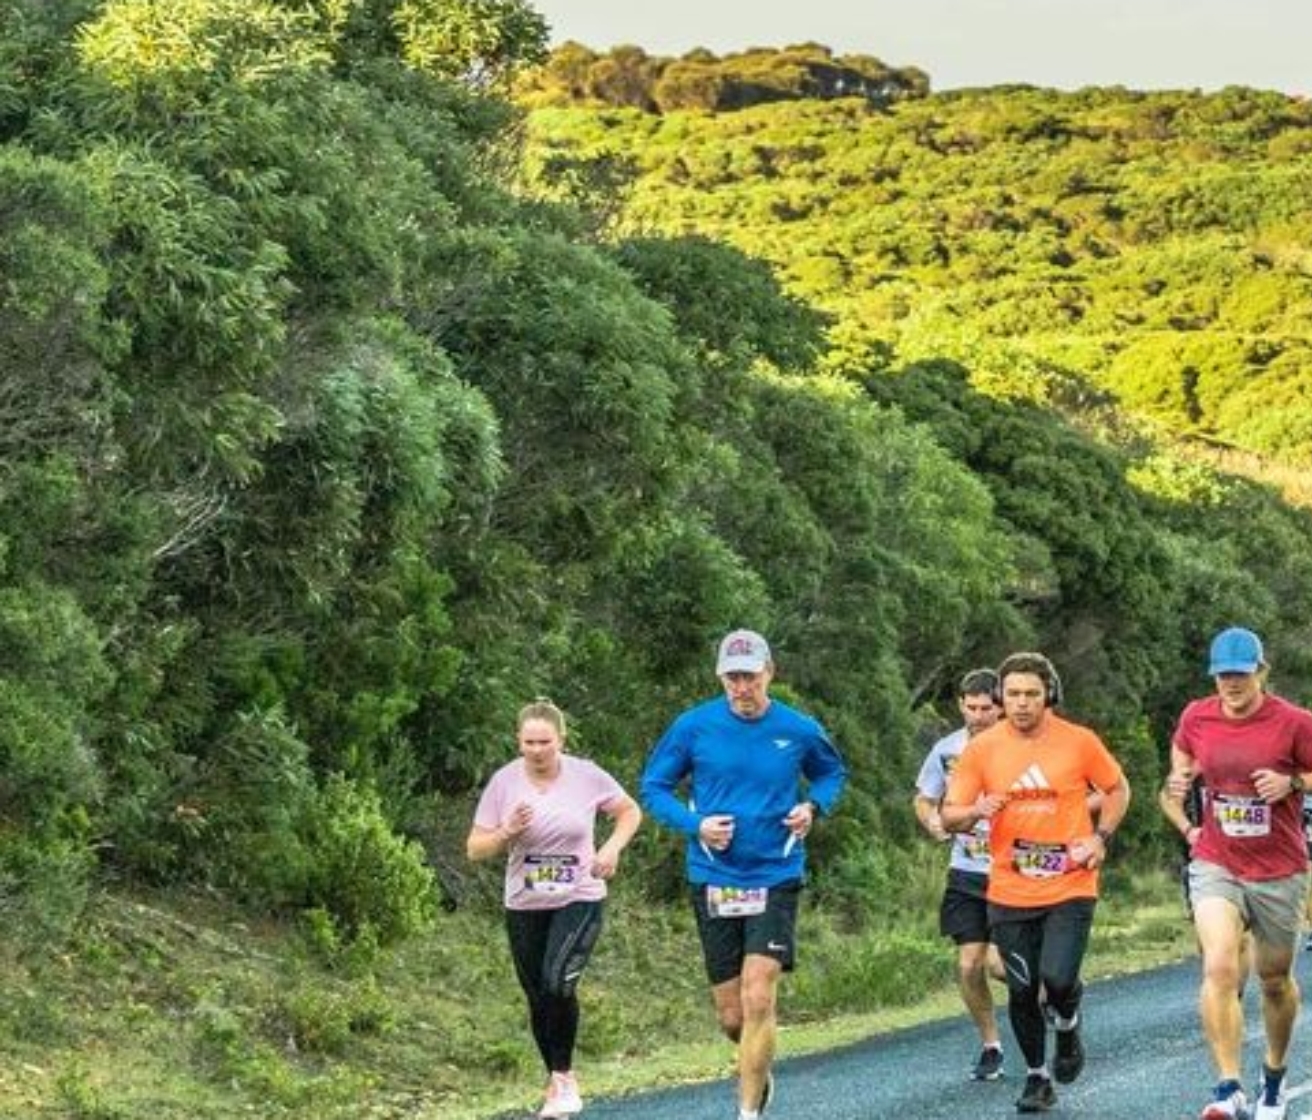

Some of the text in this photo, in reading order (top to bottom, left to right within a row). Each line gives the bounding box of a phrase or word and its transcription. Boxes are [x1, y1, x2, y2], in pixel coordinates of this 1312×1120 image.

[1224, 806, 1264, 825] 1448
[1026, 853, 1062, 871] 1422
[538, 866, 575, 883] 1423
